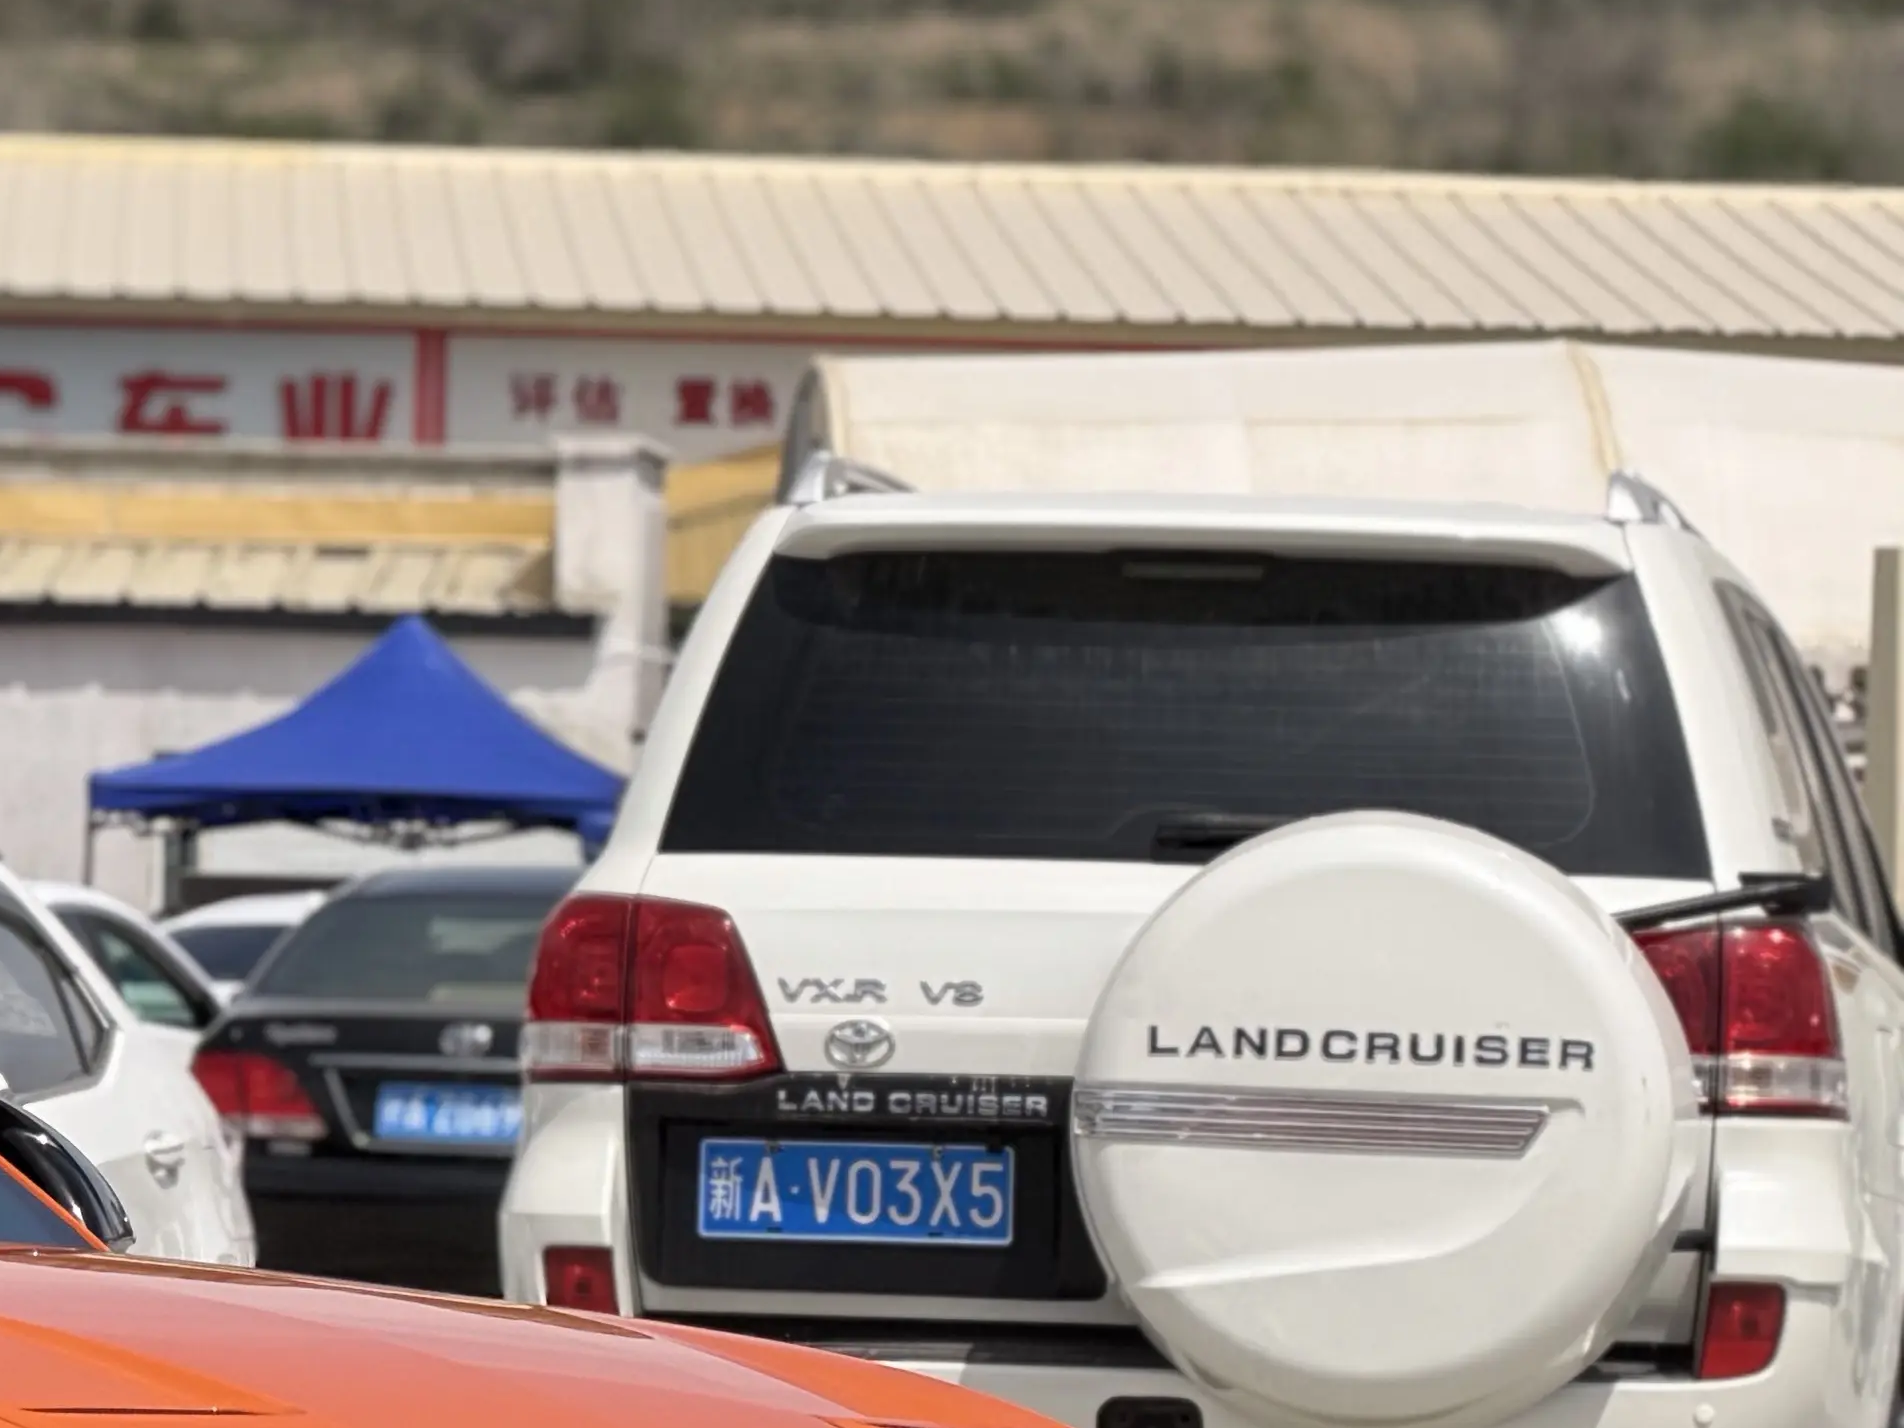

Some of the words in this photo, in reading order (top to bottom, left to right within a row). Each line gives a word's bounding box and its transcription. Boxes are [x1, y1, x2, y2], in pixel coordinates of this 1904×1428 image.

[776, 976, 889, 1005] VXR
[919, 977, 986, 1007] V8
[776, 1088, 877, 1114] LAND
[888, 1090, 1048, 1116] CRUISER
